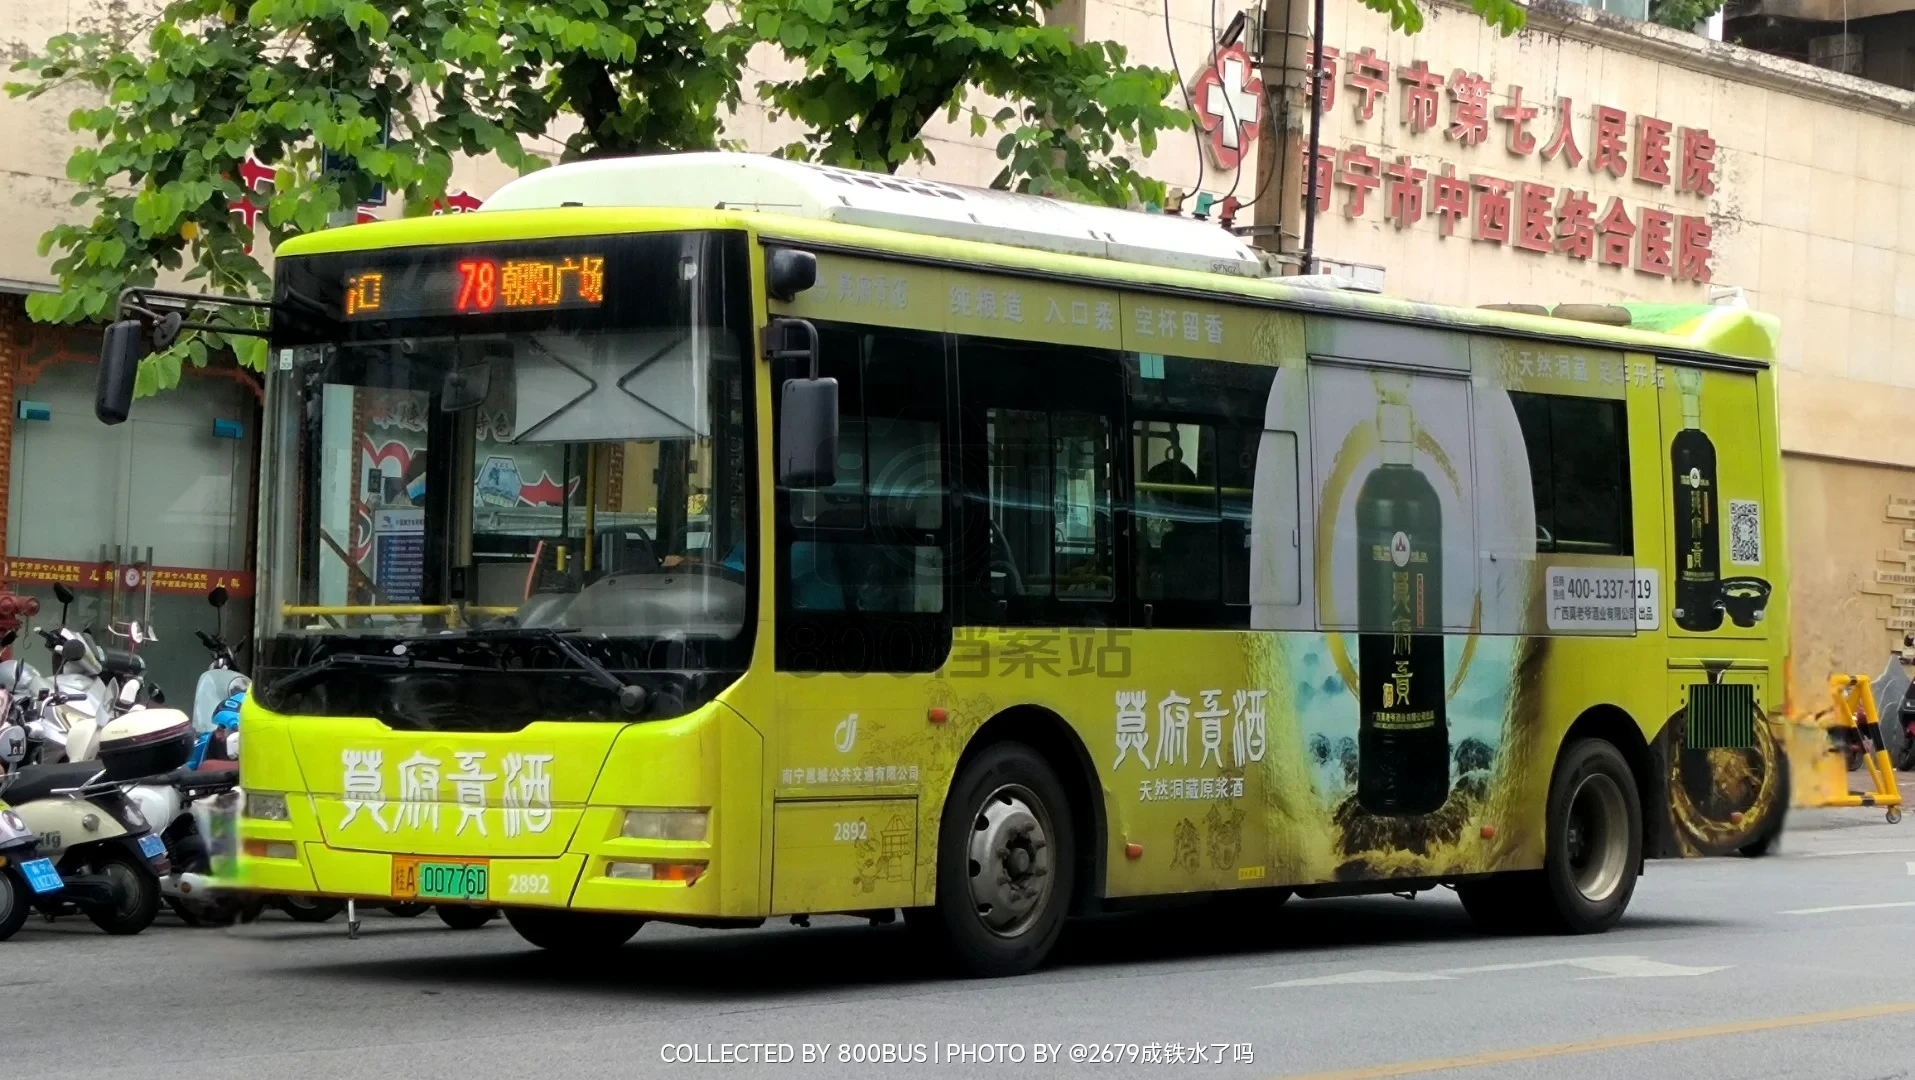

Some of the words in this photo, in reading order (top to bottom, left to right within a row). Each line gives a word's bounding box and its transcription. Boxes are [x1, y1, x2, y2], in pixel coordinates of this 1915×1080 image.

[1306, 44, 1716, 197] 南宁市第七人民医院
[1301, 141, 1714, 283] 南宁市中西医结合医院
[457, 261, 495, 311] 78
[501, 256, 604, 306] 朝阳广场
[950, 286, 1023, 323] 纯粮造
[1045, 297, 1113, 332] 入口柔
[1135, 306, 1224, 344] 空杯留香
[1567, 578, 1651, 599] 400-1337-719
[782, 766, 919, 785] 南宁邕城公共交通有限公司
[1139, 776, 1245, 801] 天然洞藏原浆酒
[833, 822, 868, 841] 2892
[424, 864, 487, 897] 00776D
[507, 873, 550, 895] 2892
